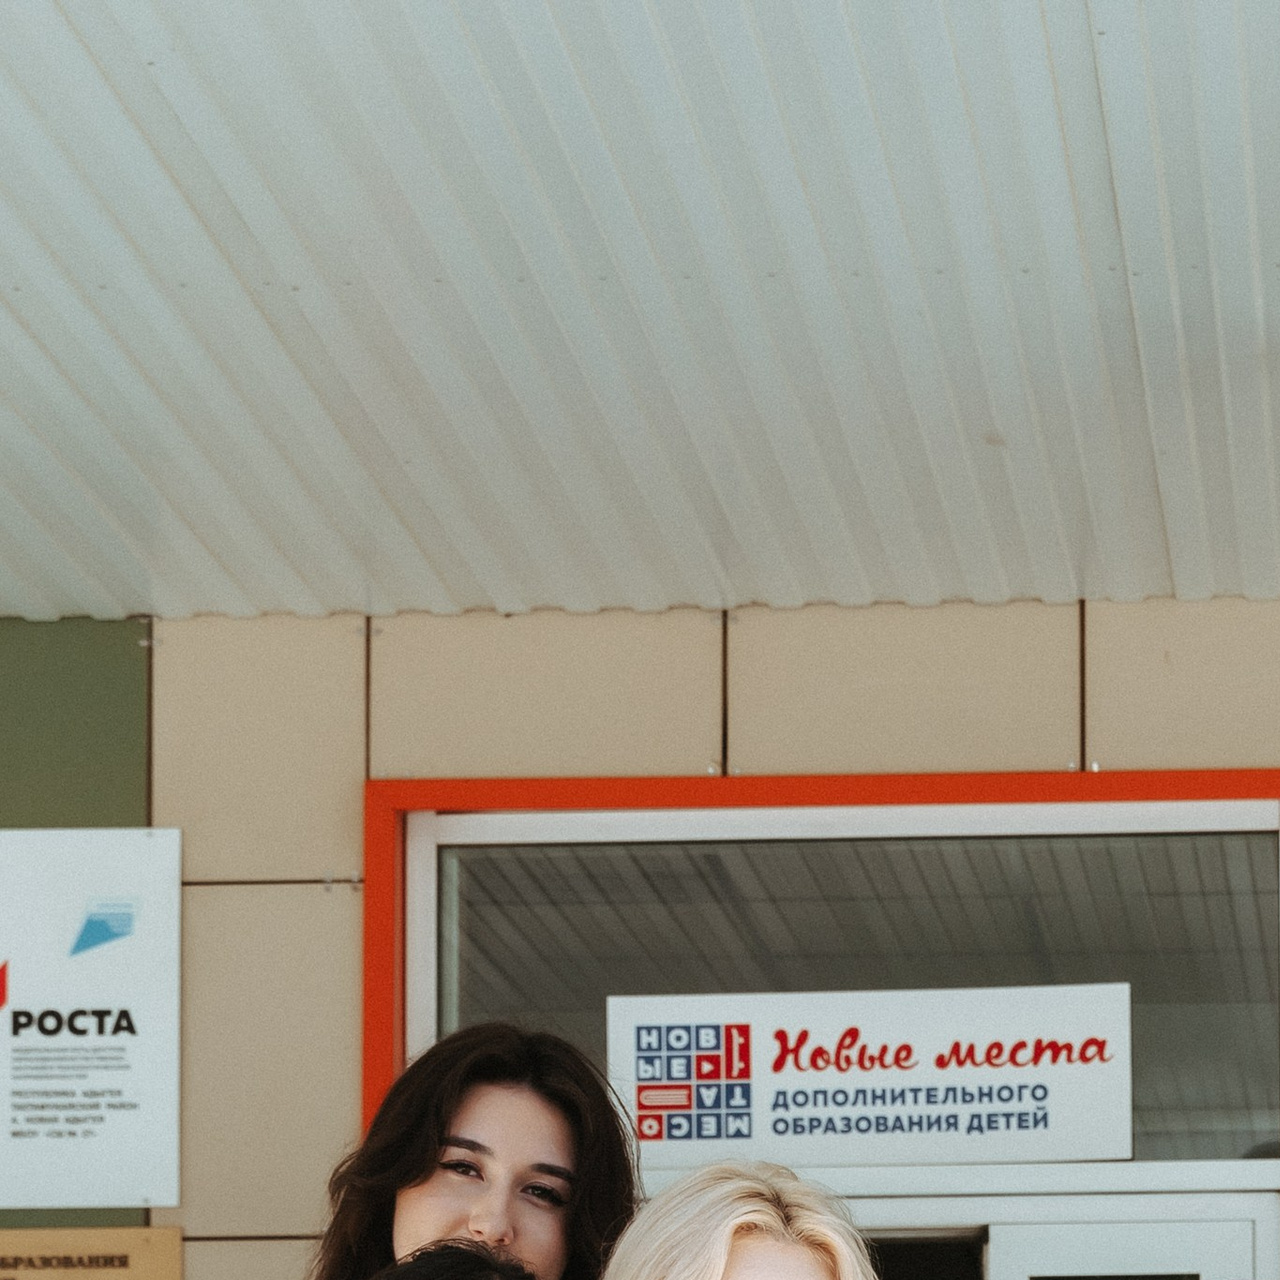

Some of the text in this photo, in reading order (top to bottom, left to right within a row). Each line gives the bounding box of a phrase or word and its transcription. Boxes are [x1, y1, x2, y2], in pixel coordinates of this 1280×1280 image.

[11, 1009, 137, 1036] РОСТА
[771, 1026, 919, 1073] Новые
[935, 1037, 1113, 1069] места
[772, 1084, 1048, 1111] ДОПОЛНИТЕЛЬНОГО
[772, 1107, 1049, 1135] ОБРАЗОВАНИЯ ДЕТЕЙ
